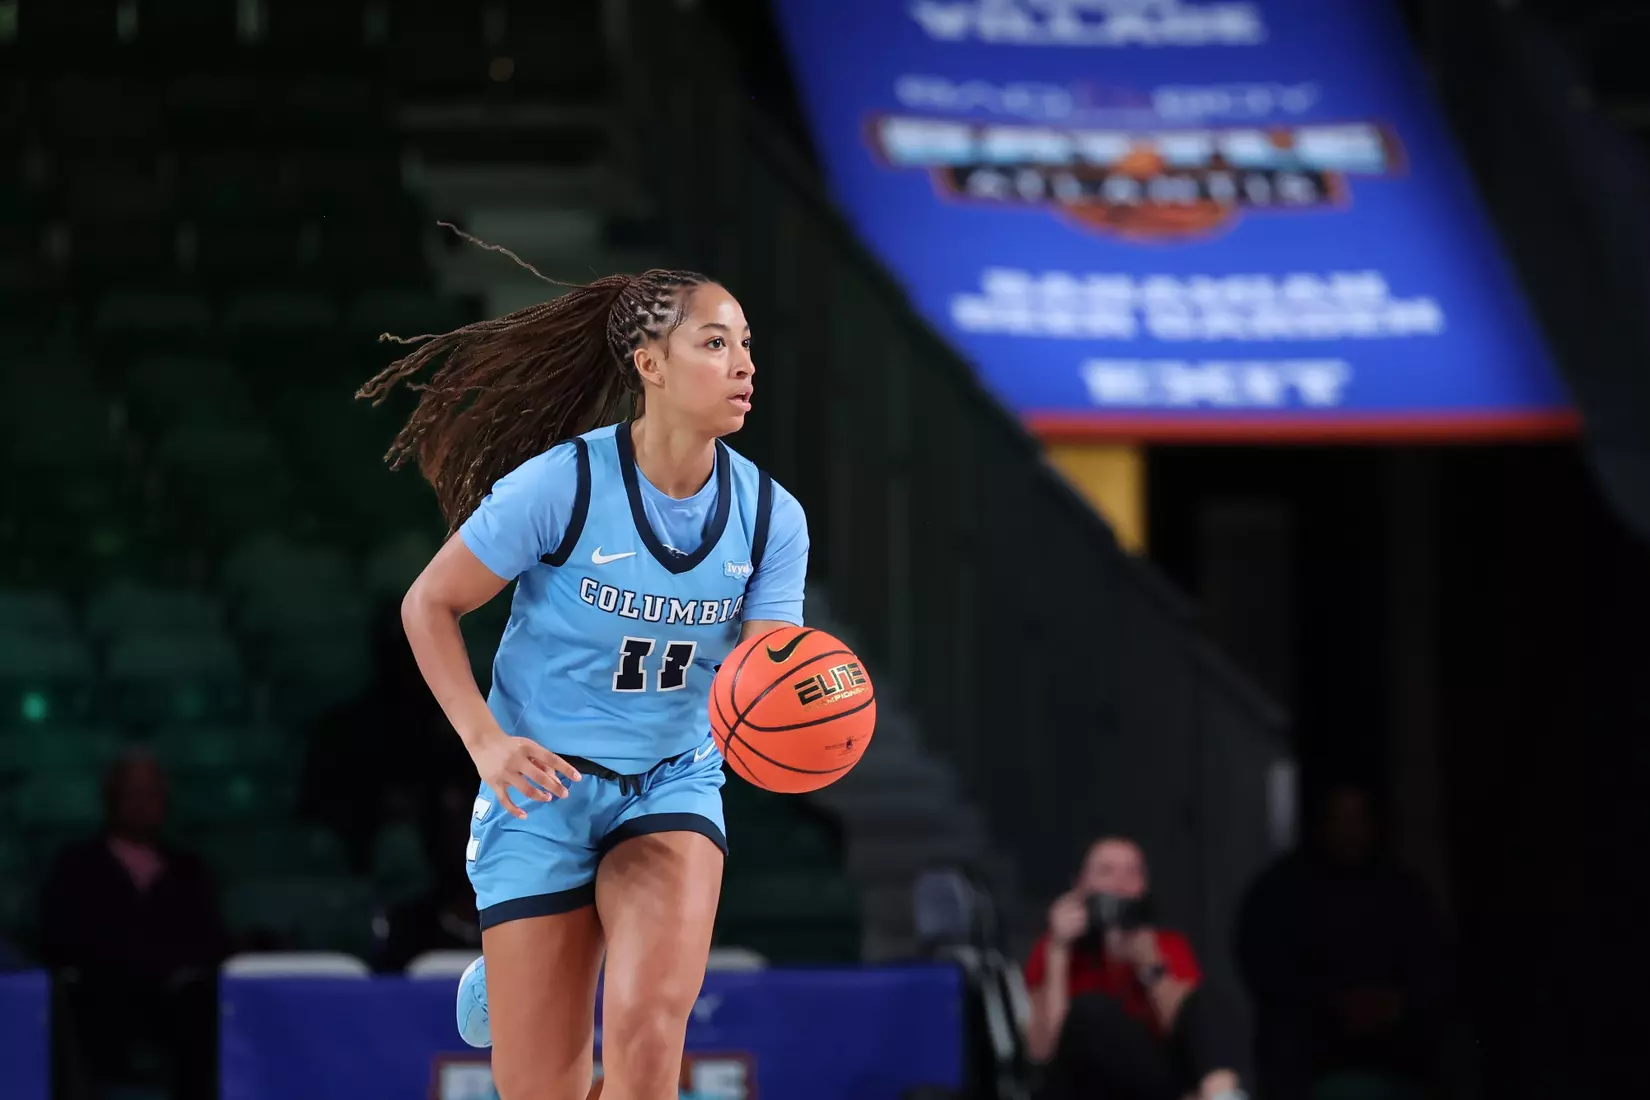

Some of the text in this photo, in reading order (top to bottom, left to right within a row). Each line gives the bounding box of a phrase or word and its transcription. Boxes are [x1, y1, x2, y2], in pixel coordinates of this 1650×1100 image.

[580, 577, 743, 625] COLUMBIA
[612, 636, 697, 692] 11
[793, 662, 866, 706] ELITE
